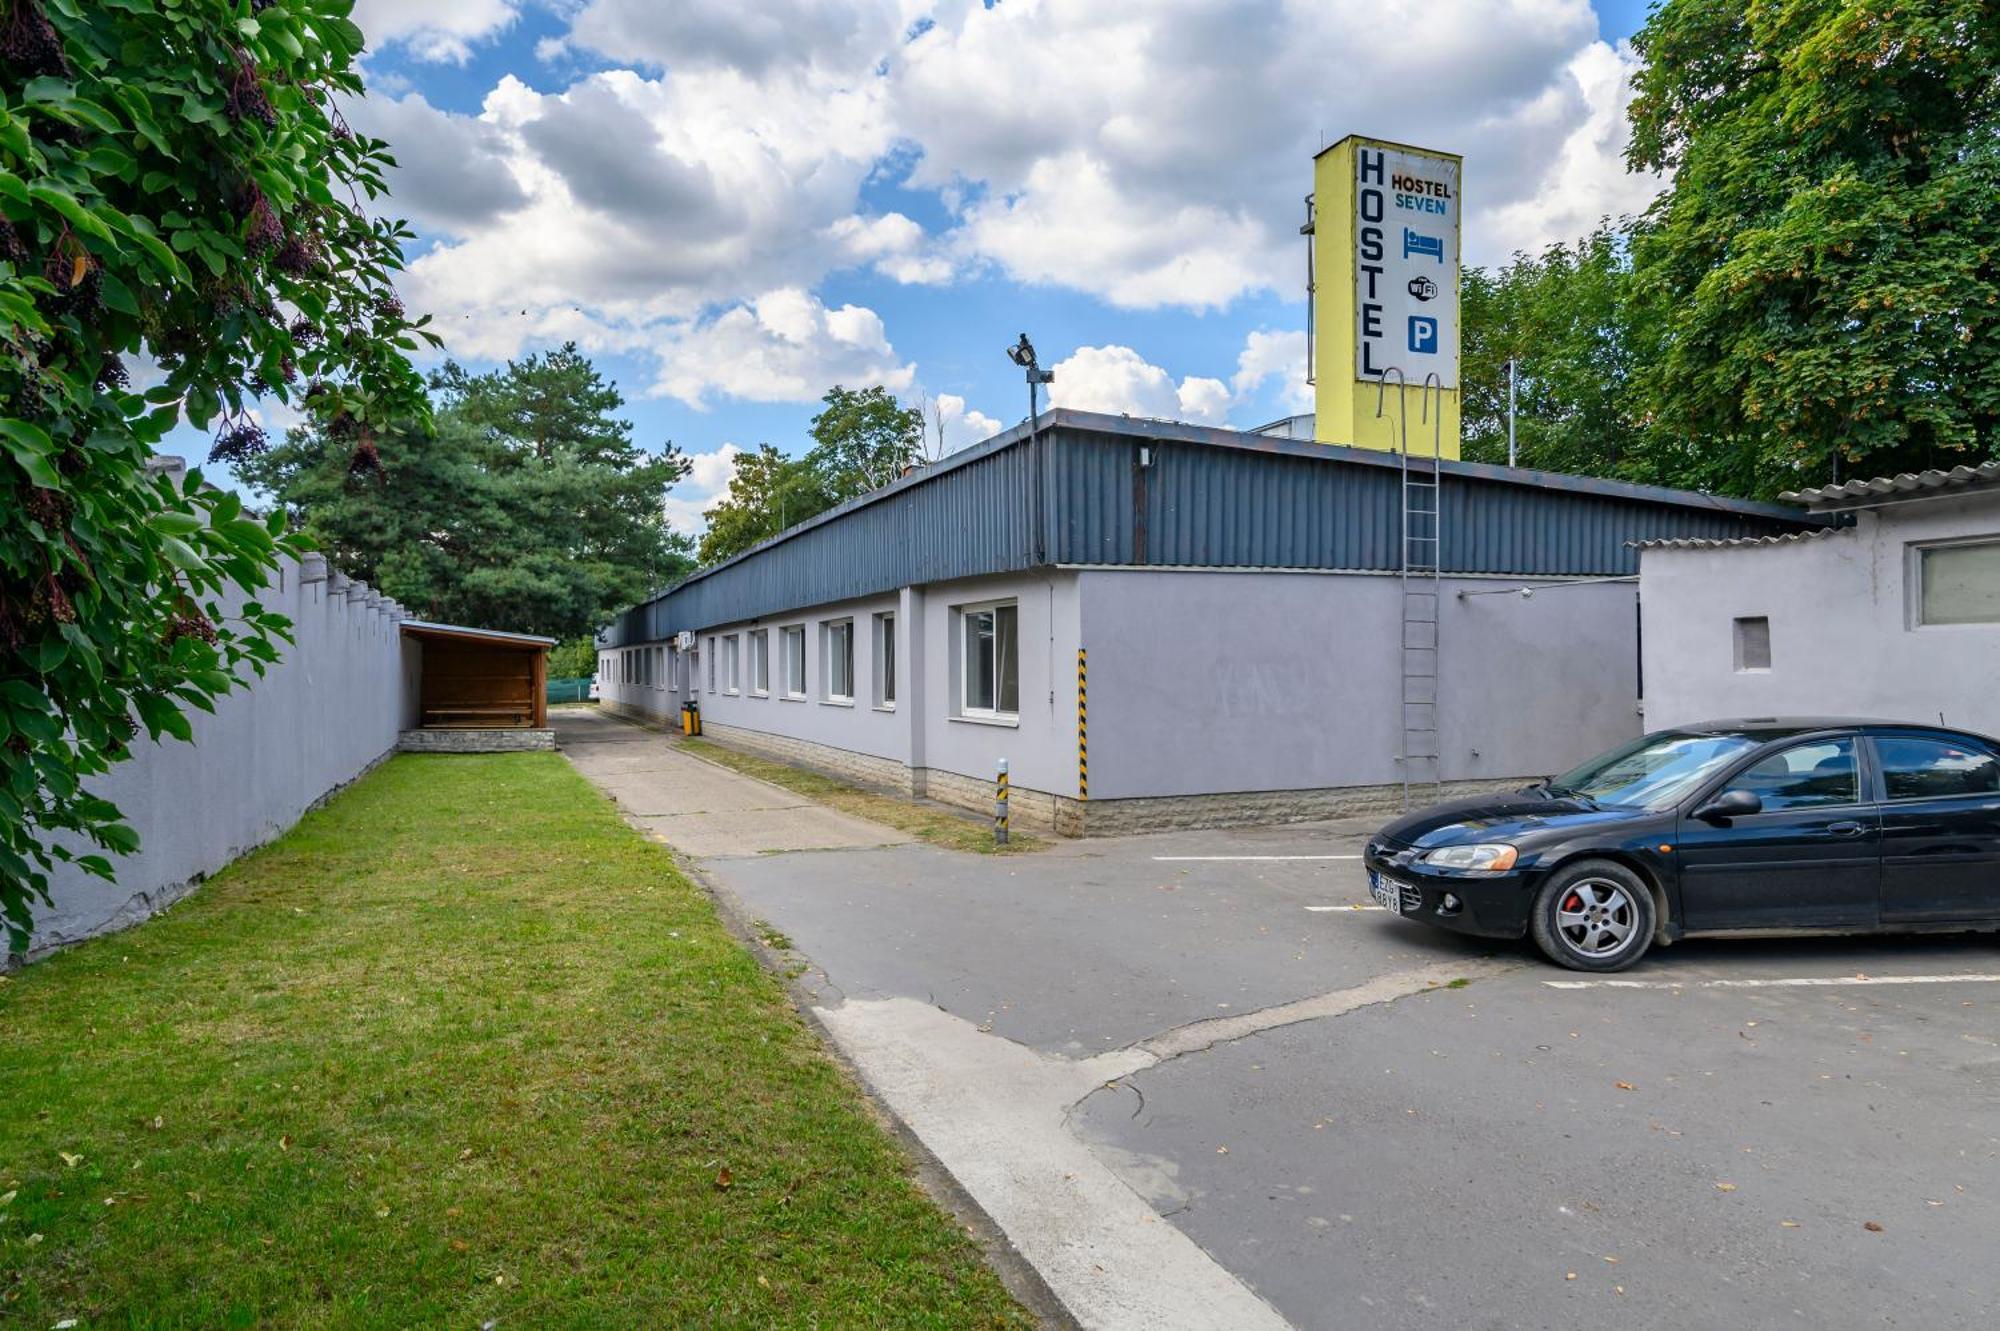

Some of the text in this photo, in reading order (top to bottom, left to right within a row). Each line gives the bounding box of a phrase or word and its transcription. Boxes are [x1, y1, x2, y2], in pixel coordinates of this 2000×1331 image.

[1392, 174, 1451, 199] HOSTEL
[1395, 193, 1446, 215] SEVEN
[1361, 149, 1384, 375] HOSTEL
[1414, 320, 1432, 349] P
